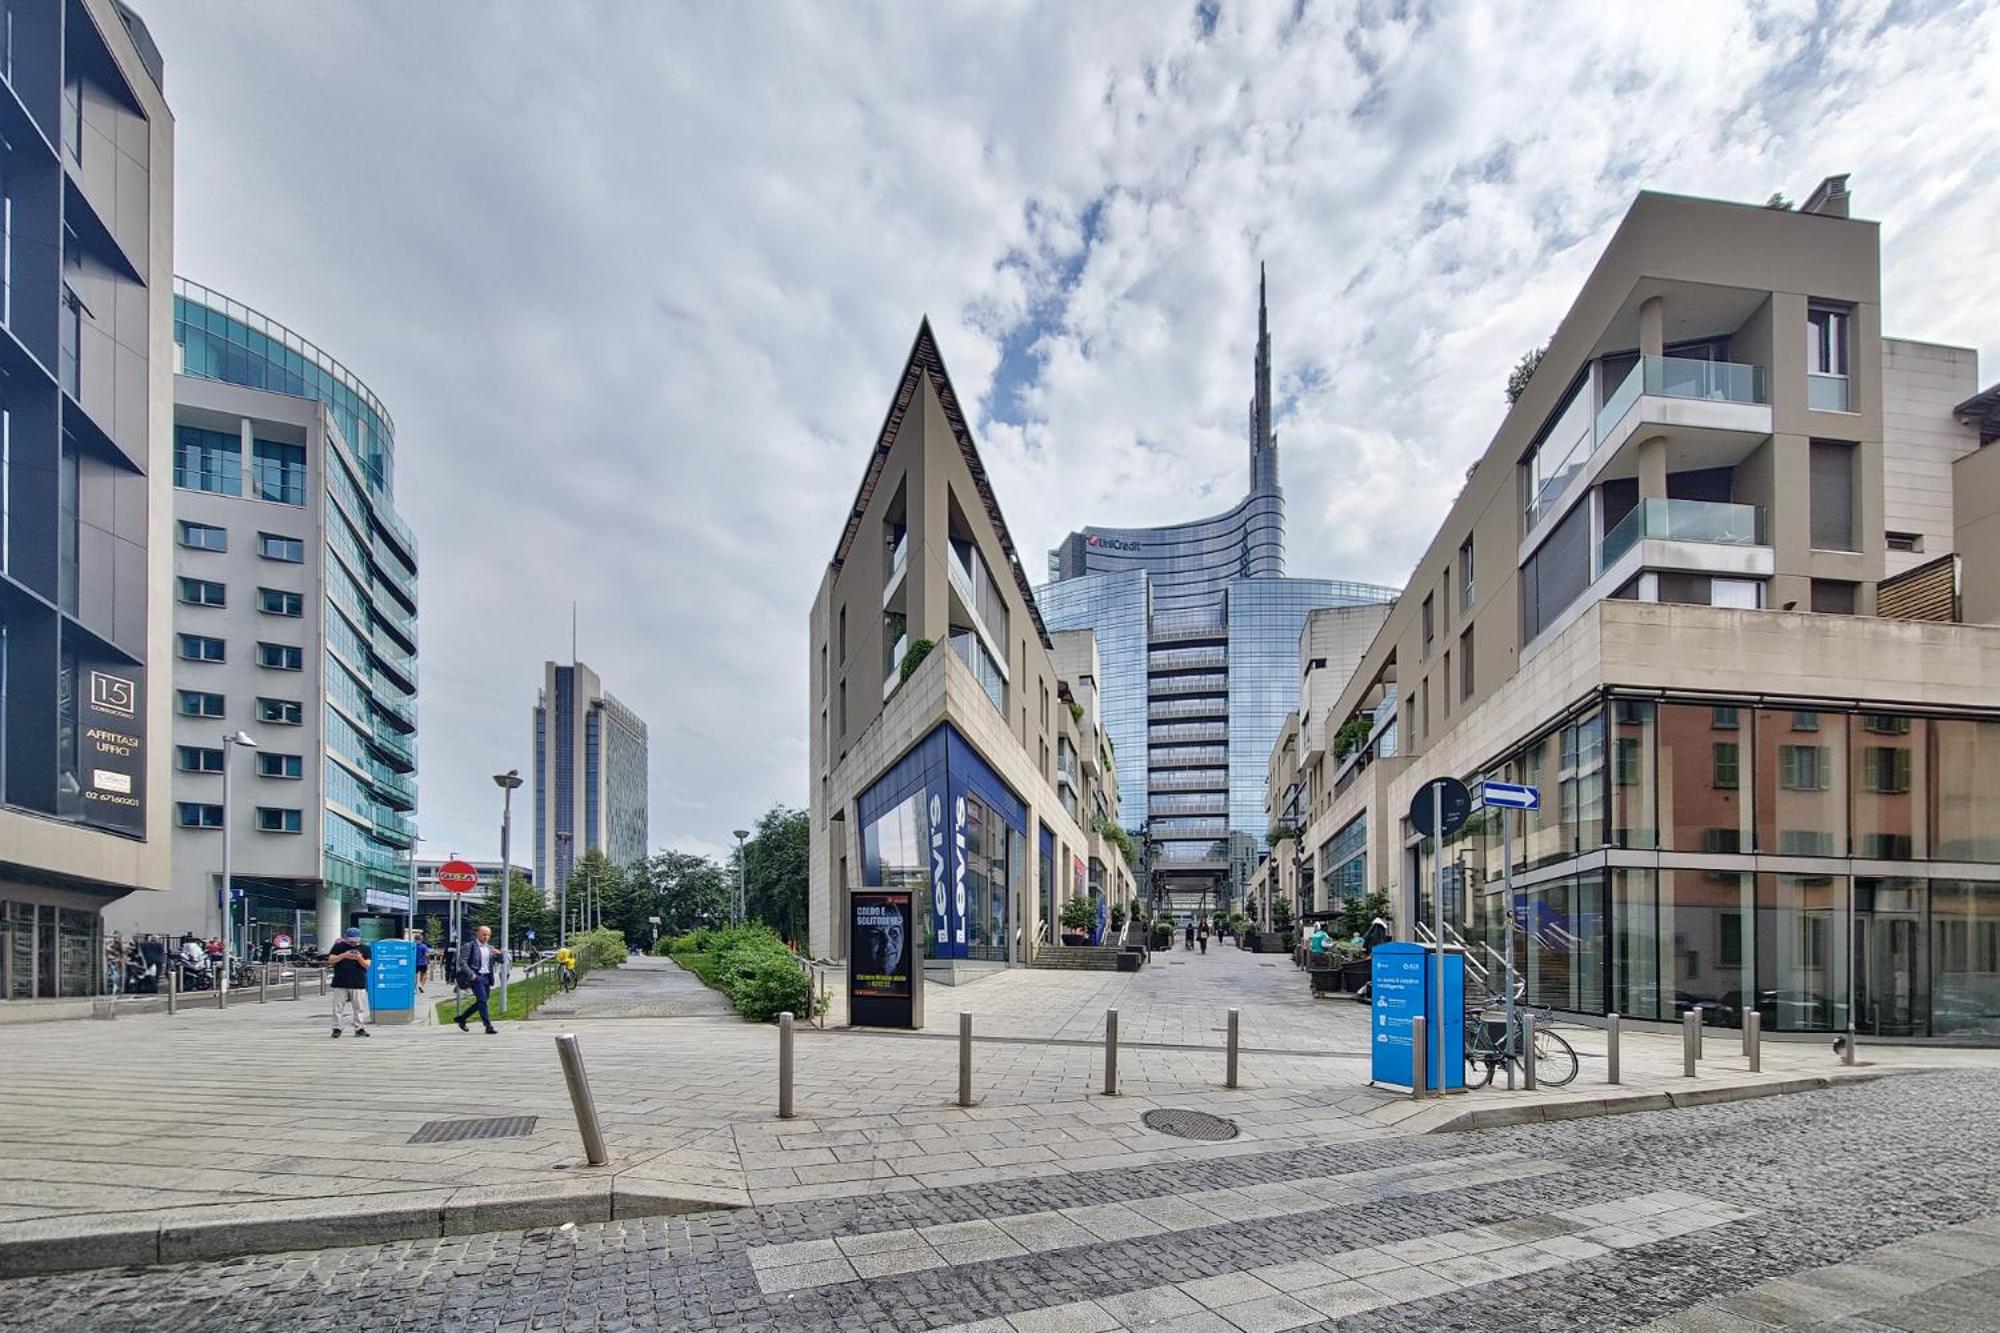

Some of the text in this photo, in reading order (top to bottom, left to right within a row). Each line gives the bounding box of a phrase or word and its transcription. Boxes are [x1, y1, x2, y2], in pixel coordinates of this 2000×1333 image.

[1099, 537, 1141, 552] UniCredit
[98, 679, 128, 704] 15
[87, 729, 138, 747] AFFITTASI
[96, 743, 130, 757] UFFICI
